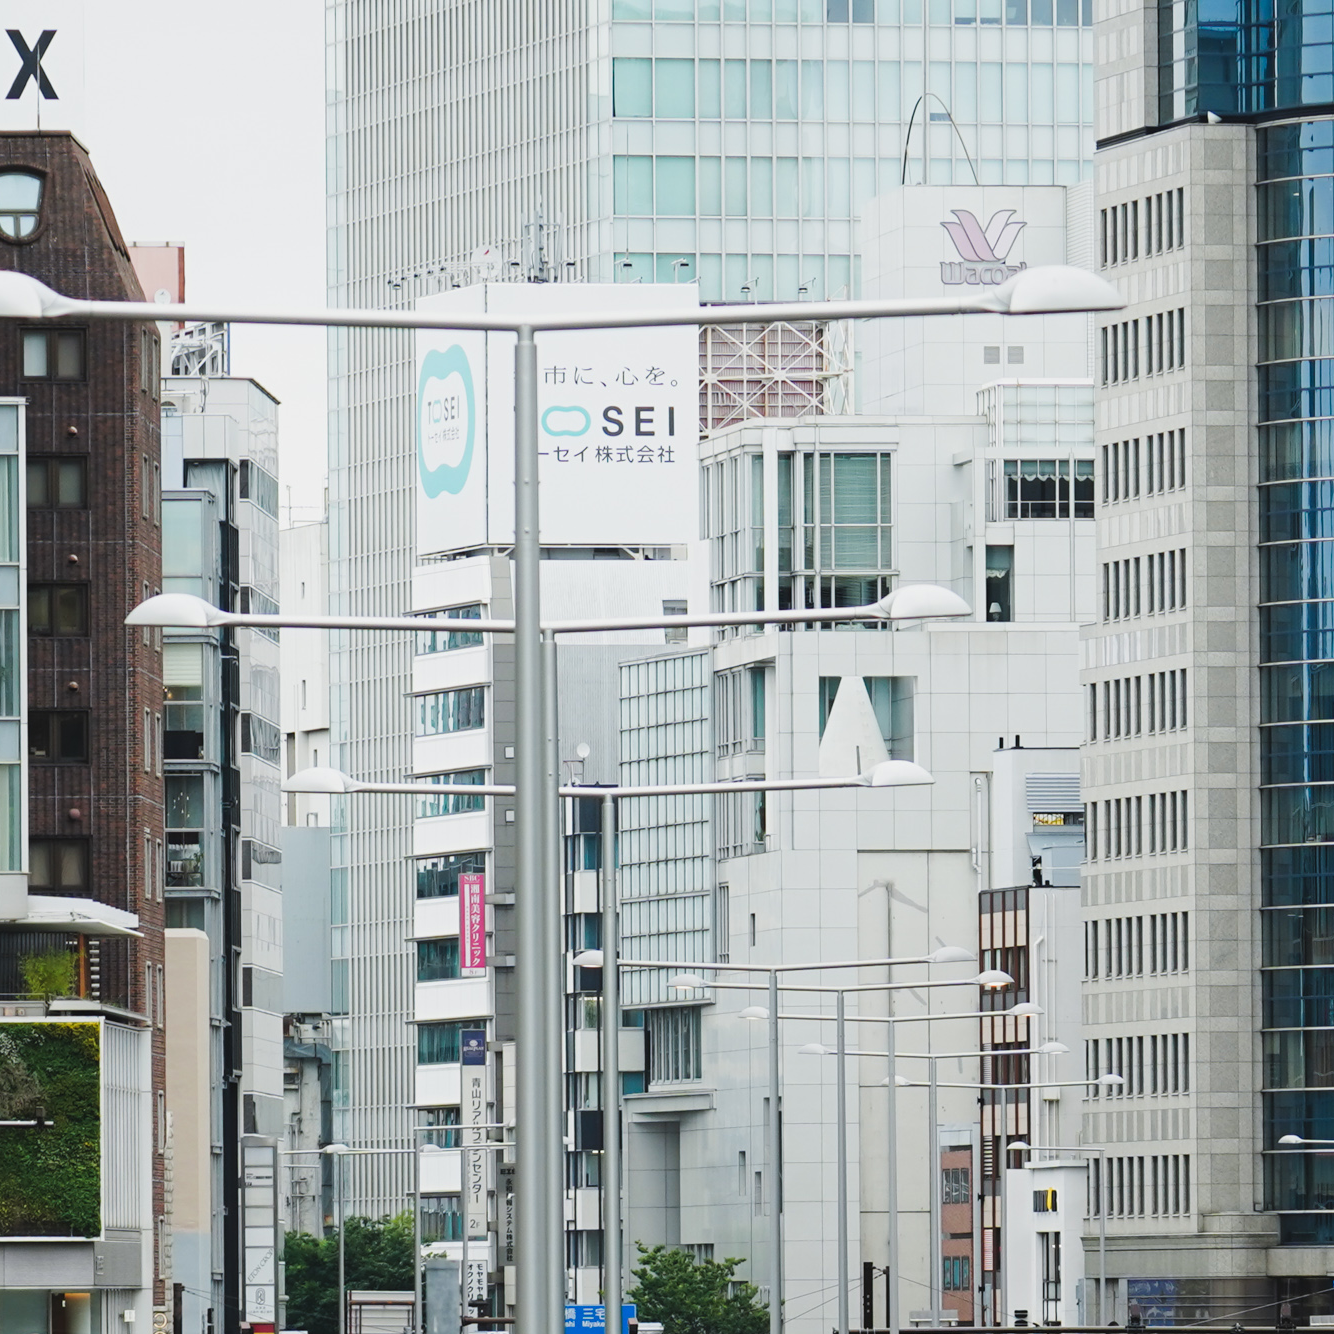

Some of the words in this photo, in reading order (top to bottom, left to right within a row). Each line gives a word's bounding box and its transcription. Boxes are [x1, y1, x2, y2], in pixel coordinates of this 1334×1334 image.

[940, 260, 1027, 286] Wacoa
[470, 883, 482, 967] 湘南美容クリニック
